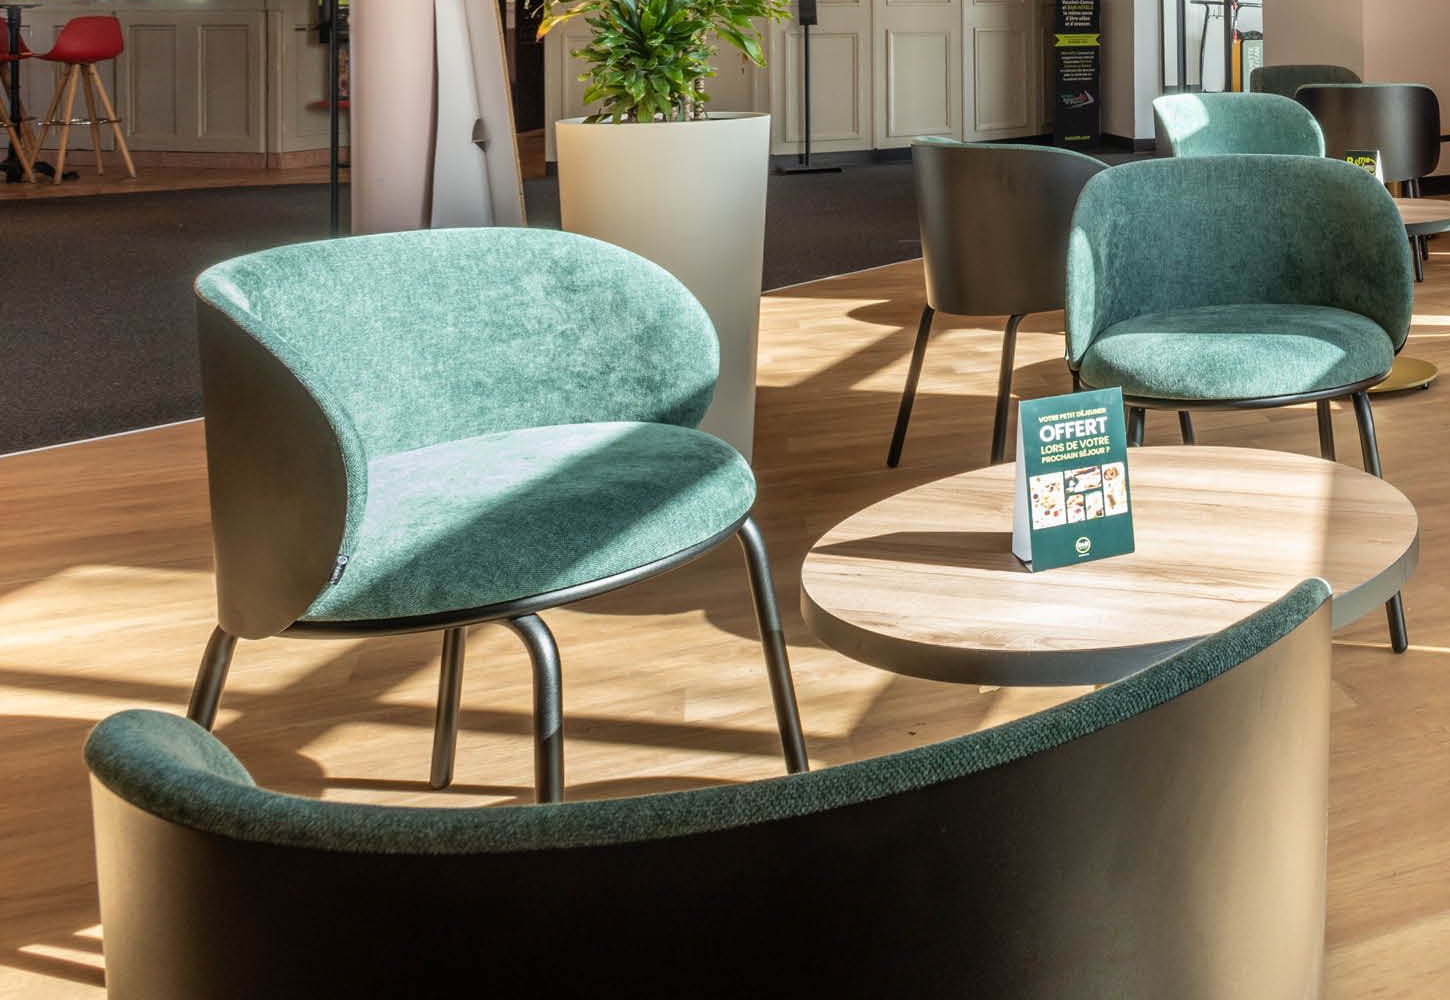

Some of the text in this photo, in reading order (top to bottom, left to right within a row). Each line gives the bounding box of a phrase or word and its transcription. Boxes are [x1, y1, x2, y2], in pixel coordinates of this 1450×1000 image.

[1038, 414, 1059, 423] VOTRE
[1060, 412, 1076, 421] PETIT
[1039, 416, 1108, 442] OFFERT
[1040, 436, 1110, 455] LORS DE VOTRE
[1041, 451, 1078, 464] PROCHAIN
[1079, 447, 1105, 458] SÉJOUR
